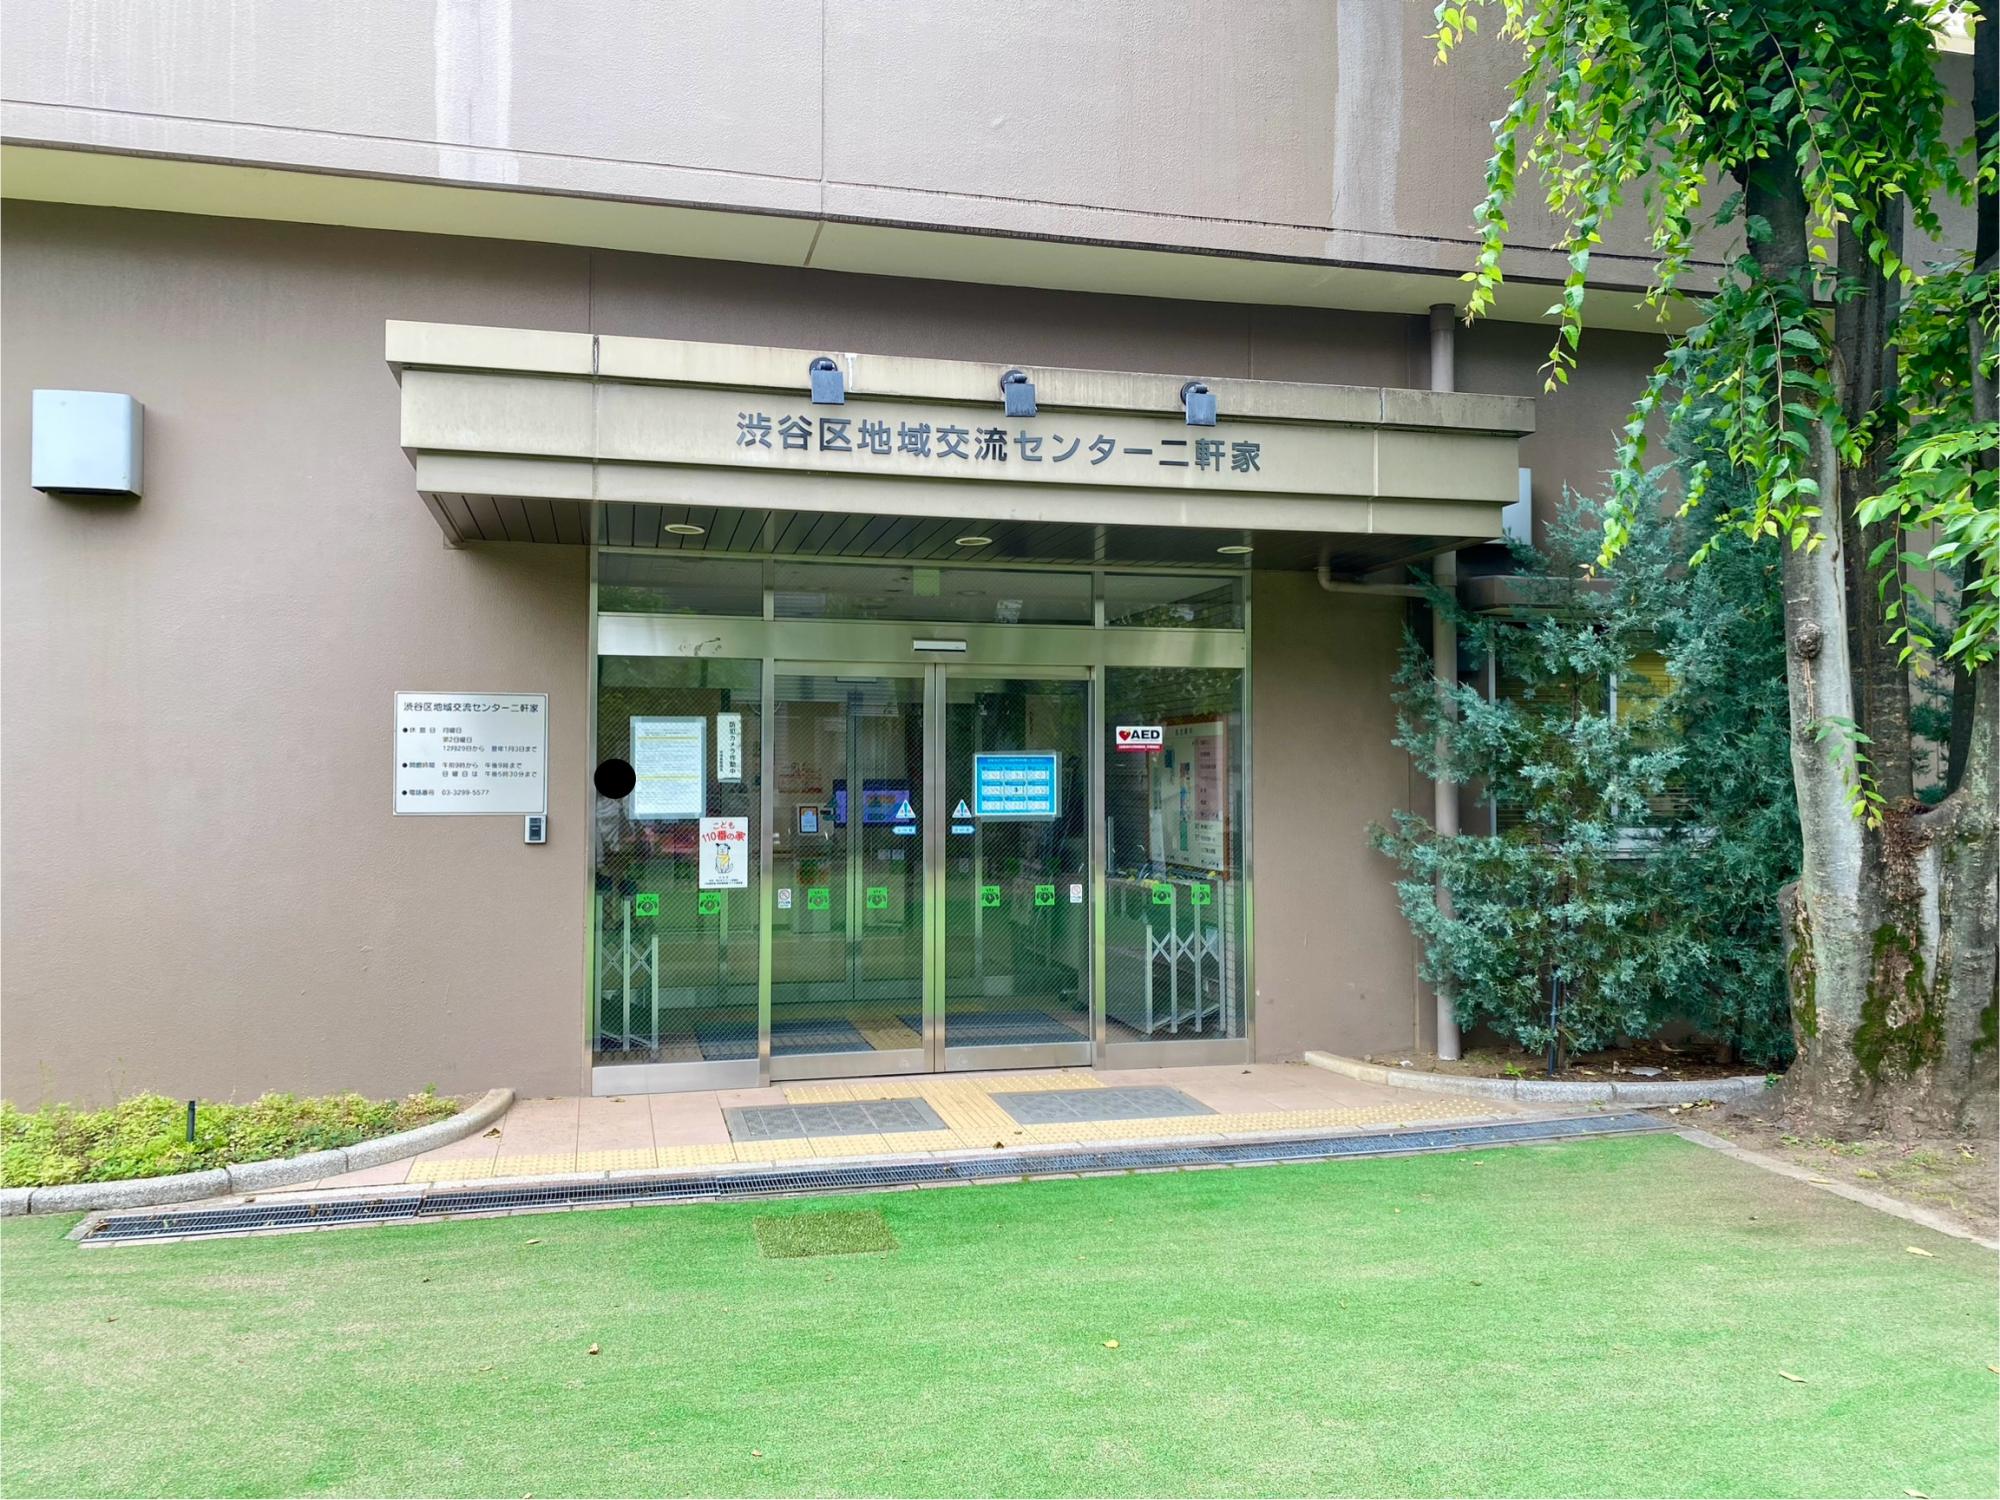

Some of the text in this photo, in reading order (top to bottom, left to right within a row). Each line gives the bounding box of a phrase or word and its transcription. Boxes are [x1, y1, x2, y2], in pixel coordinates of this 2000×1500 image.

[736, 411, 1262, 474] 渋谷区地域交流センター二軒家
[403, 701, 539, 713] 渋谷区地域交流センター二軒家
[1131, 729, 1160, 739] AED
[712, 821, 736, 830] こども
